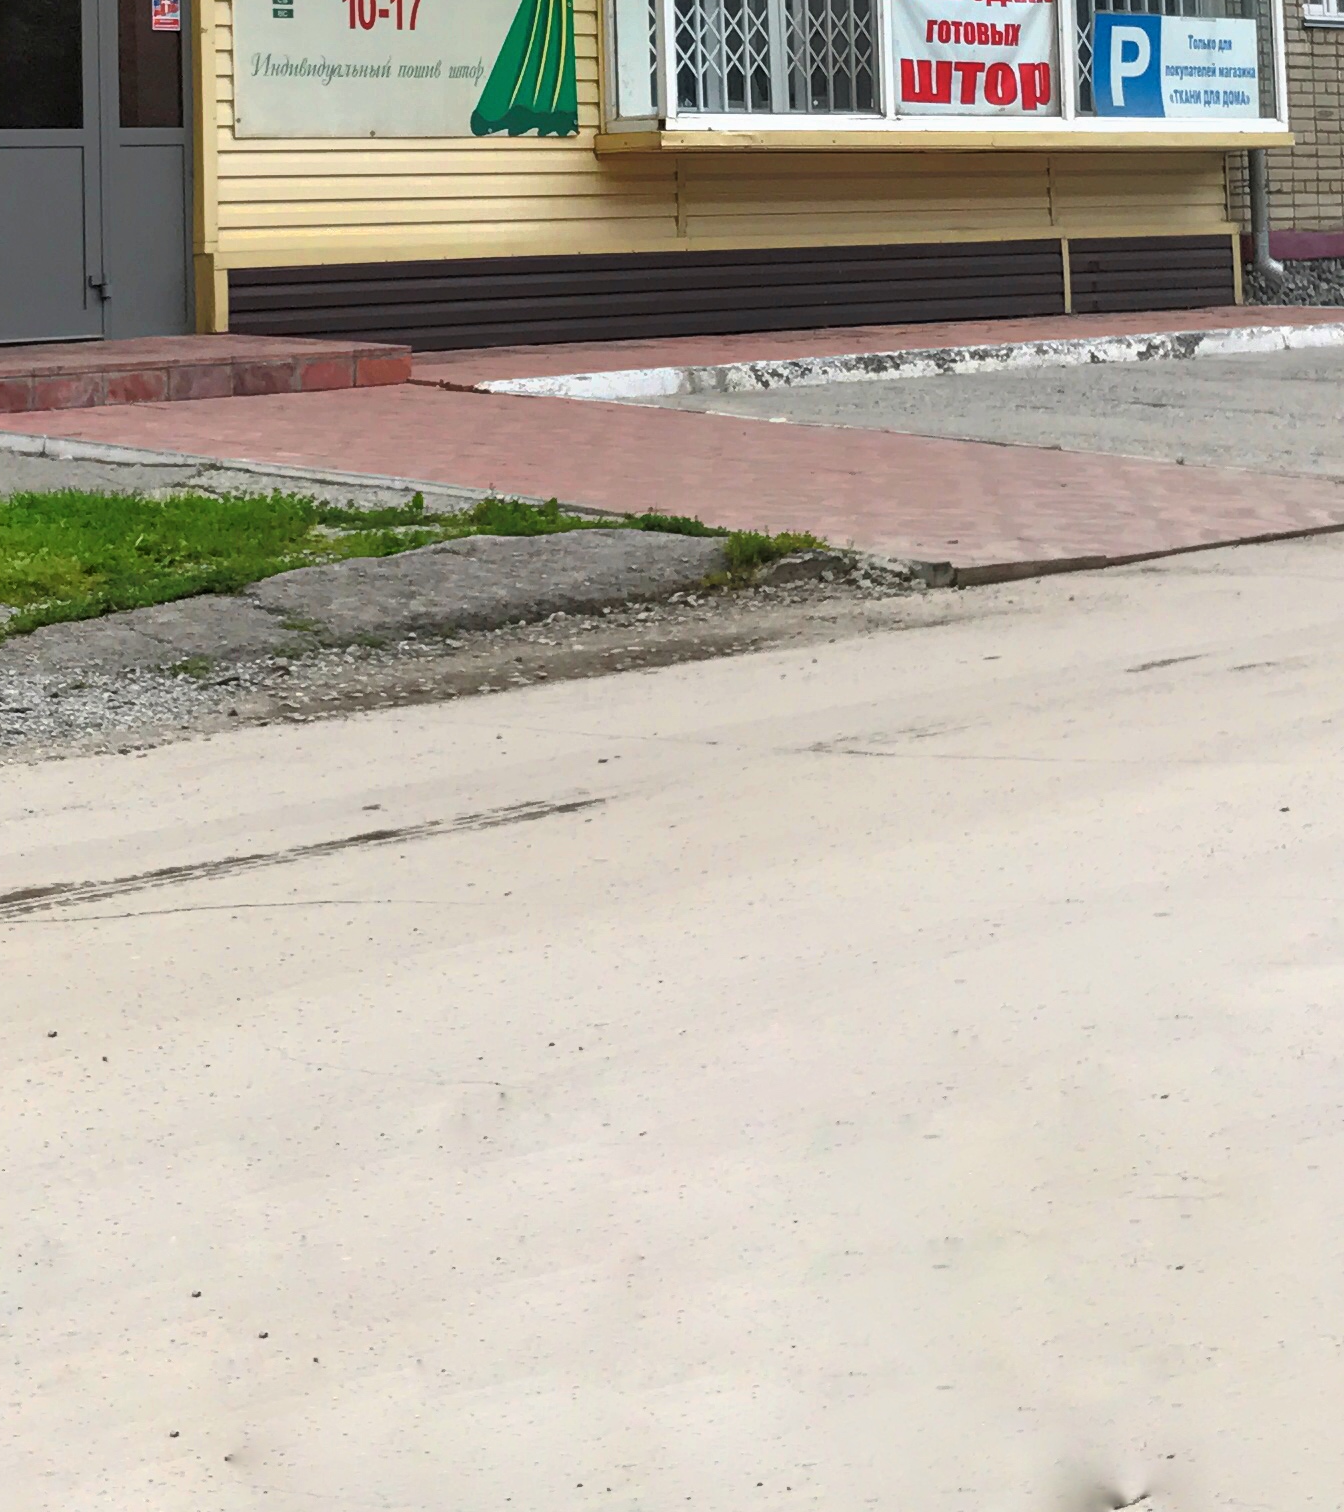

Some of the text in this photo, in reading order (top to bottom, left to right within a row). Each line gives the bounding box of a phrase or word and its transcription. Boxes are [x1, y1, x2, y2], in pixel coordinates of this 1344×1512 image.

[1187, 34, 1233, 53] Только для
[251, 52, 484, 87] Индивидуальный пошив штор
[1110, 26, 1151, 107] P
[1165, 62, 1257, 80] покупателей магазина
[1169, 89, 1251, 109] «ТКАНИ ДЛЯ ДОМА»
